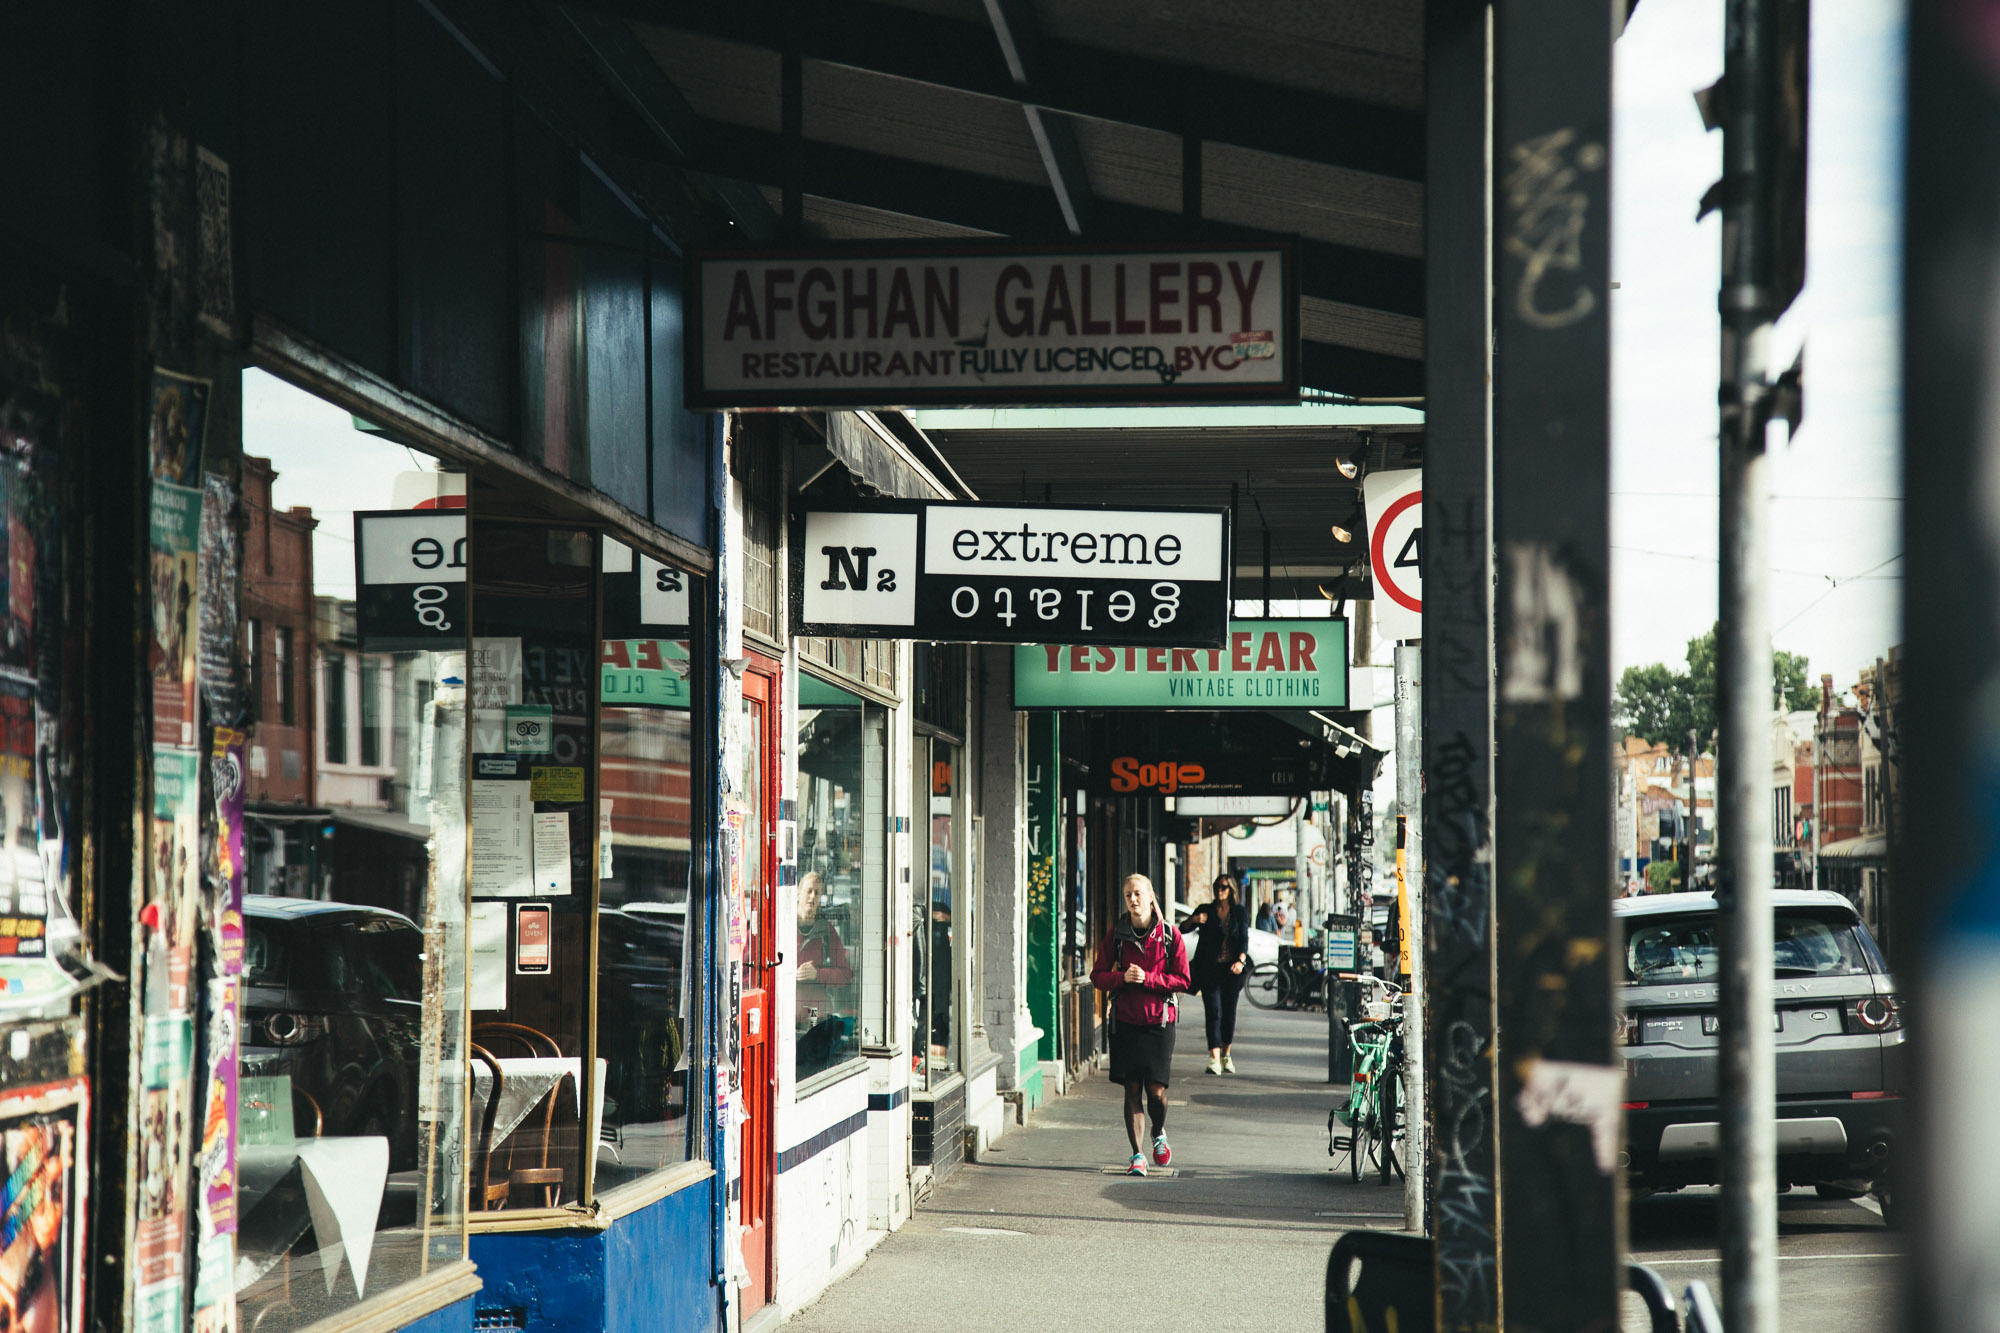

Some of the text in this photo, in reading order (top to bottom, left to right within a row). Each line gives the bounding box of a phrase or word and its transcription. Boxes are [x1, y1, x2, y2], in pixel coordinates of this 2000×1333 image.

[723, 260, 1265, 341] AFGHAN GALLERY
[741, 351, 955, 379] RESTAURANT
[960, 347, 1029, 375] FULLY
[1034, 346, 1164, 373] LICENCED
[952, 522, 1182, 566] extreme
[1393, 527, 1423, 579] 4
[951, 581, 1182, 630] gelato
[1169, 678, 1320, 697] VINTAGE CLOTHING
[1110, 757, 1206, 794] Sogo
